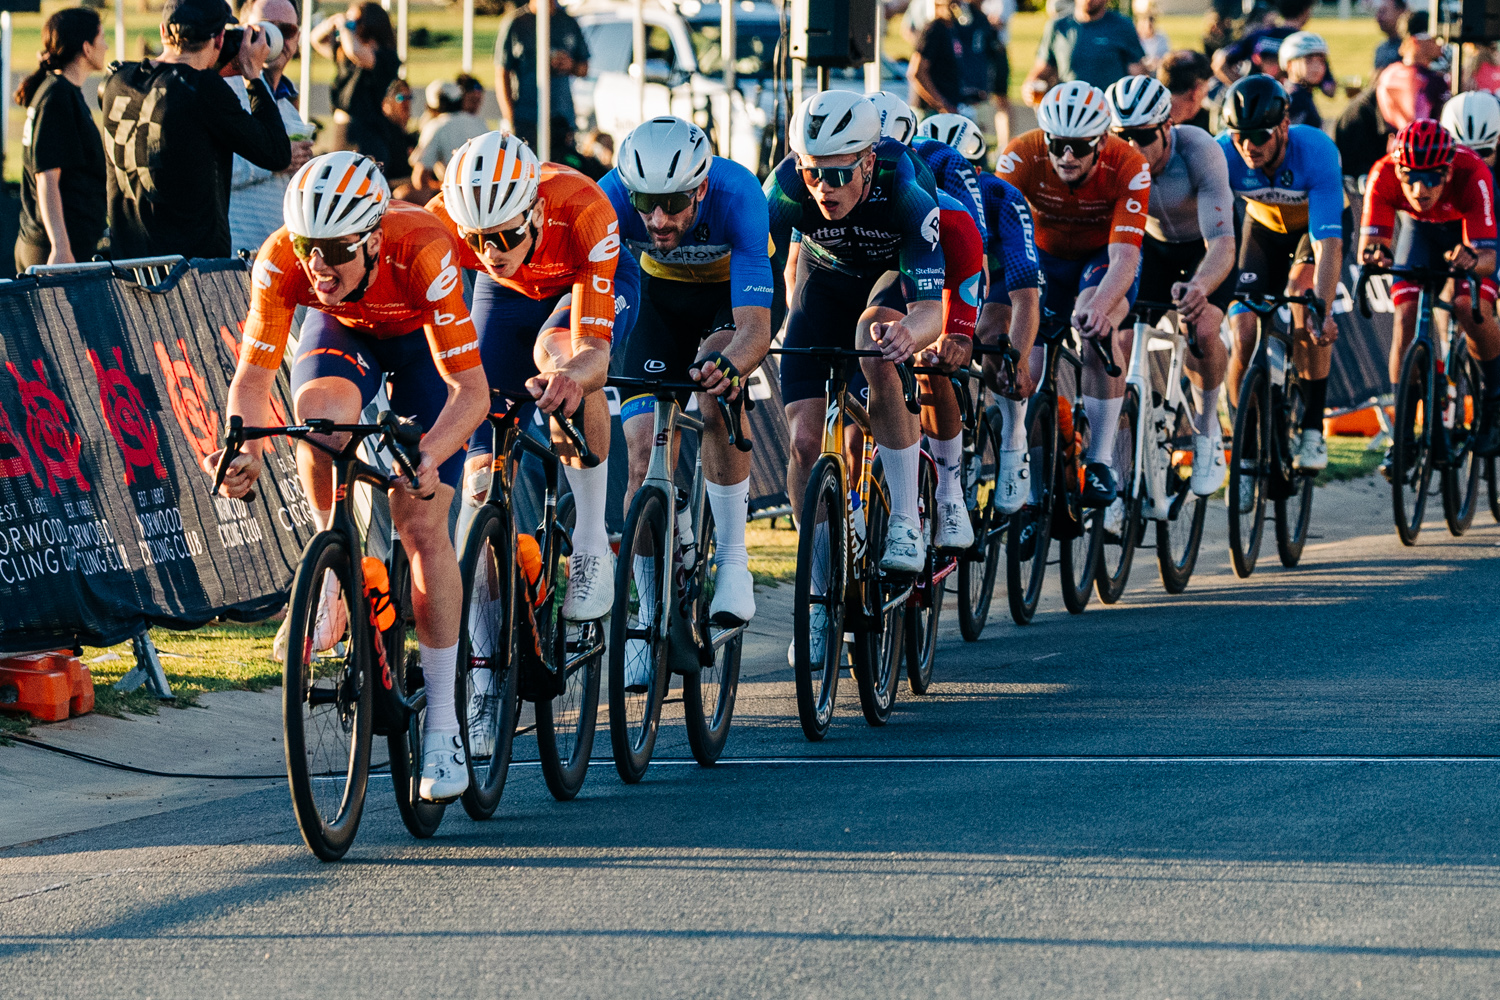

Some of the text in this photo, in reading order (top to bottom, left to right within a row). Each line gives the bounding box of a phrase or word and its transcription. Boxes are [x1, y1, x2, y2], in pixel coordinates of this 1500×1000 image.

[954, 168, 987, 230] GIANT
[804, 226, 848, 241] utter
[1011, 201, 1039, 263] GIANT
[0, 518, 68, 556] ORWOOD
[68, 518, 115, 550] ORWOOD
[135, 507, 184, 539] NORWOOD
[0, 547, 60, 584] CLING
[138, 530, 203, 566] CYCLING CLUB
